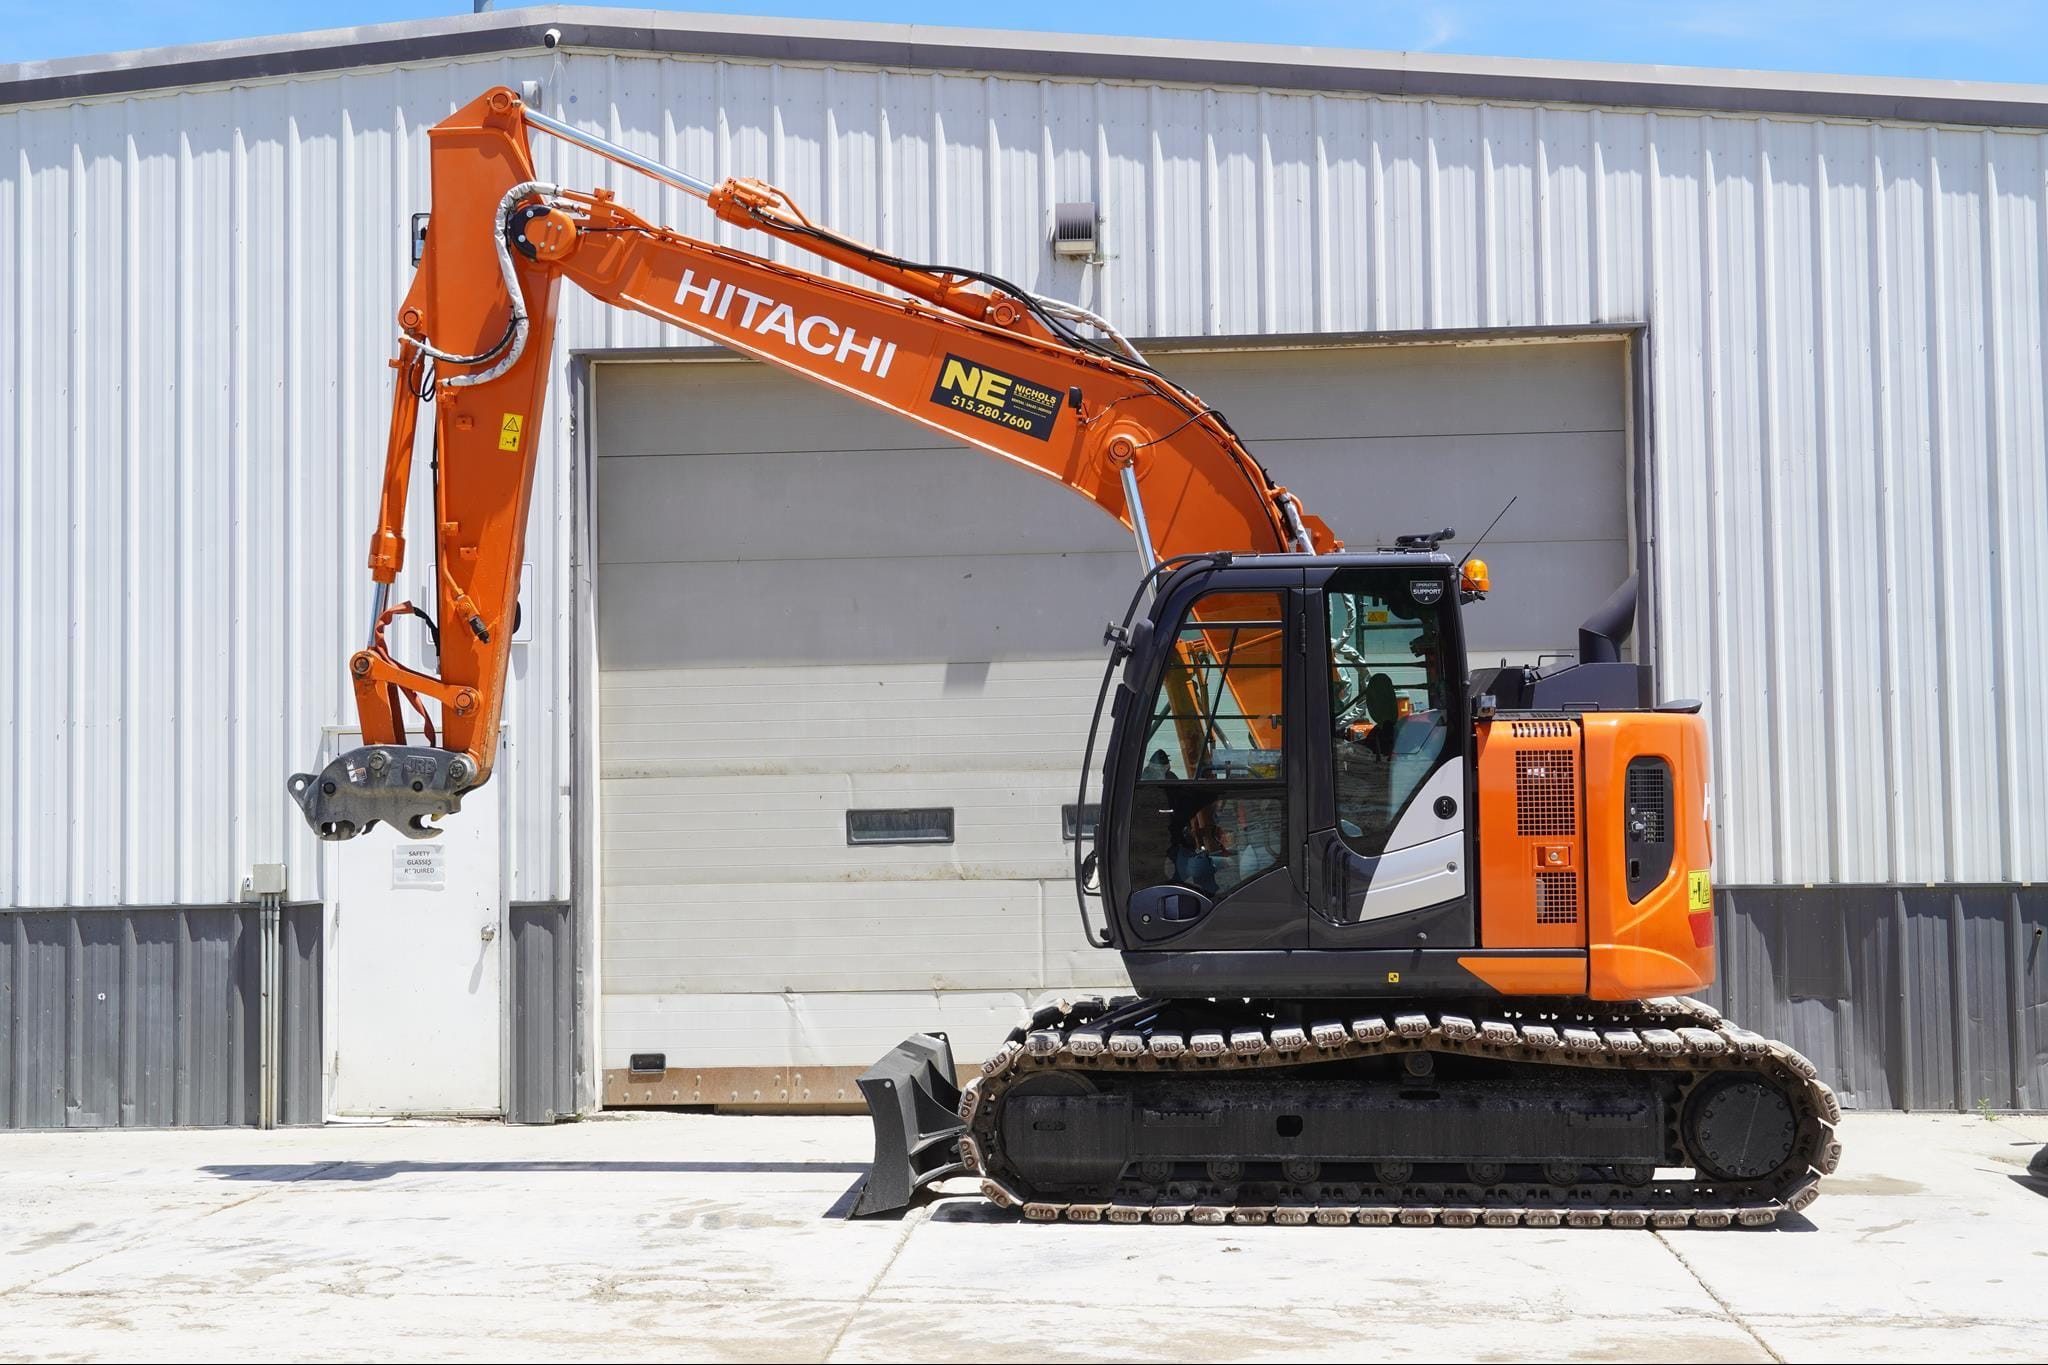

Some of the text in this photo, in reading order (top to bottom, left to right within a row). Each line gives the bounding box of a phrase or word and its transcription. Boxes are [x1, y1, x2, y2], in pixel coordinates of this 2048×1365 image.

[674, 269, 897, 378] HITACHI
[940, 359, 1012, 408] NE
[1014, 384, 1057, 404] NICHOLS
[951, 395, 1032, 430] 515.280.7600
